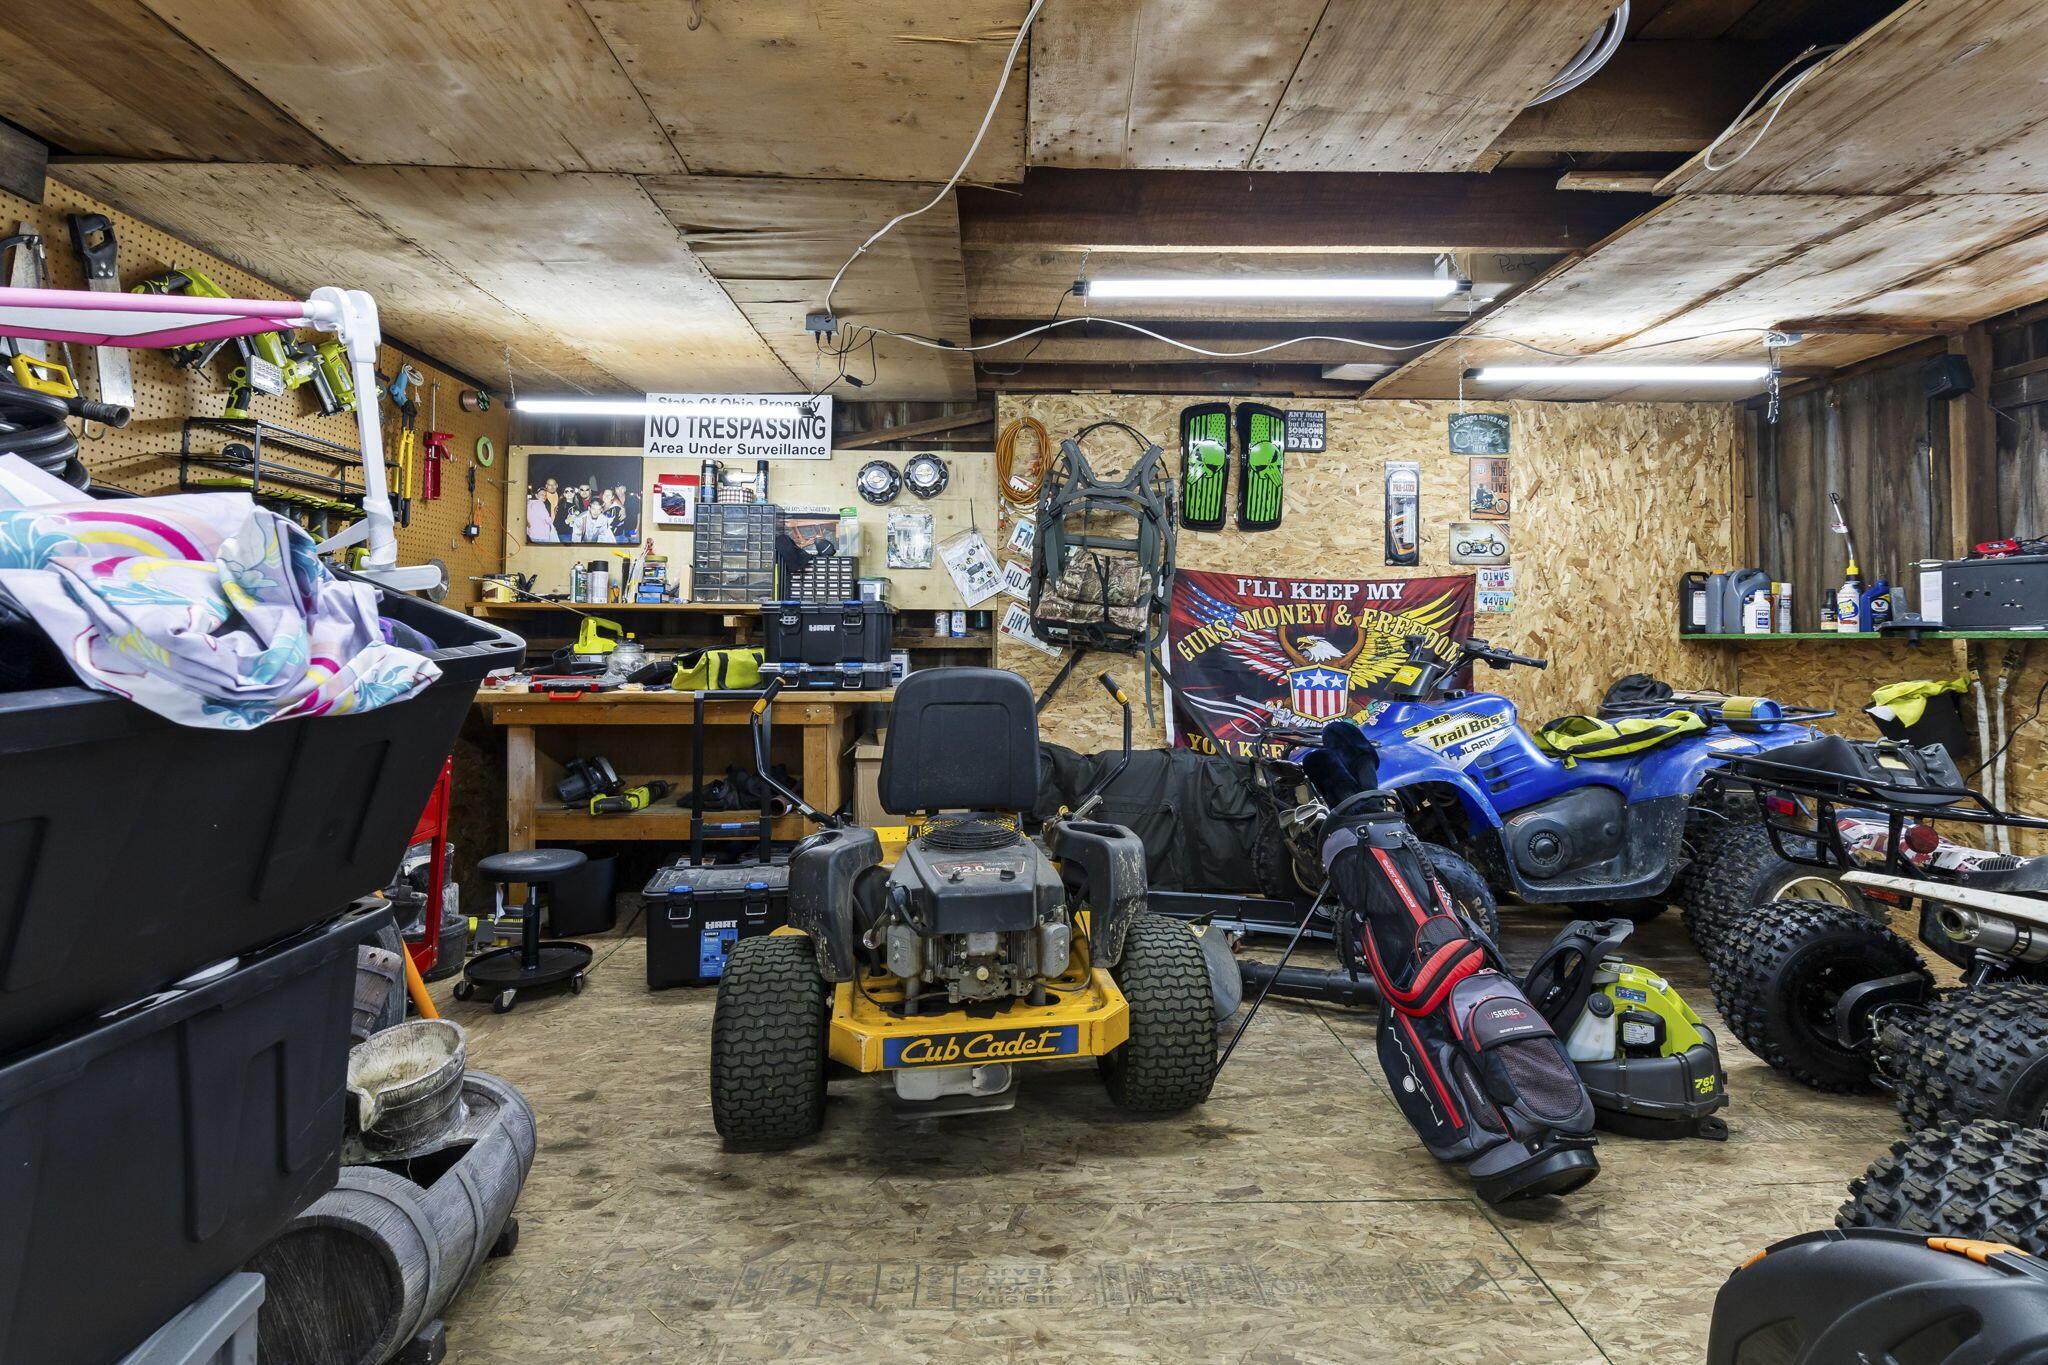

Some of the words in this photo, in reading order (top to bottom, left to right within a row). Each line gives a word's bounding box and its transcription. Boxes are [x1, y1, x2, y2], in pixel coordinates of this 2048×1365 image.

[650, 415, 680, 438] NO
[687, 416, 826, 440] TRESPASSING
[1288, 427, 1324, 435] SOMEONE
[650, 442, 683, 454] Area
[689, 442, 733, 455] Under
[737, 443, 826, 455] Surveillance
[1288, 438, 1324, 449] DAD
[1491, 466, 1507, 476] RIDE
[1491, 483, 1507, 494] LIVE
[1237, 578, 1283, 599] I'LL
[1290, 582, 1360, 600] KEEP
[1366, 583, 1406, 600] MY
[1482, 596, 1510, 606] 44VBV
[1176, 618, 1241, 662] GUNS,
[1243, 603, 1326, 632] MONEY
[1336, 604, 1353, 626] &
[1359, 608, 1465, 665] FREEDOM
[1401, 714, 1451, 737] 330
[1430, 725, 1468, 749] Trail
[1469, 711, 1508, 735] Boss
[1529, 832, 1559, 849] AUTOMATIC
[705, 920, 738, 930] HART
[901, 1036, 960, 1064] Cub
[964, 1029, 1062, 1059] Cadet
[1695, 1074, 1715, 1089] 760
[1701, 1085, 1714, 1094] CFM
